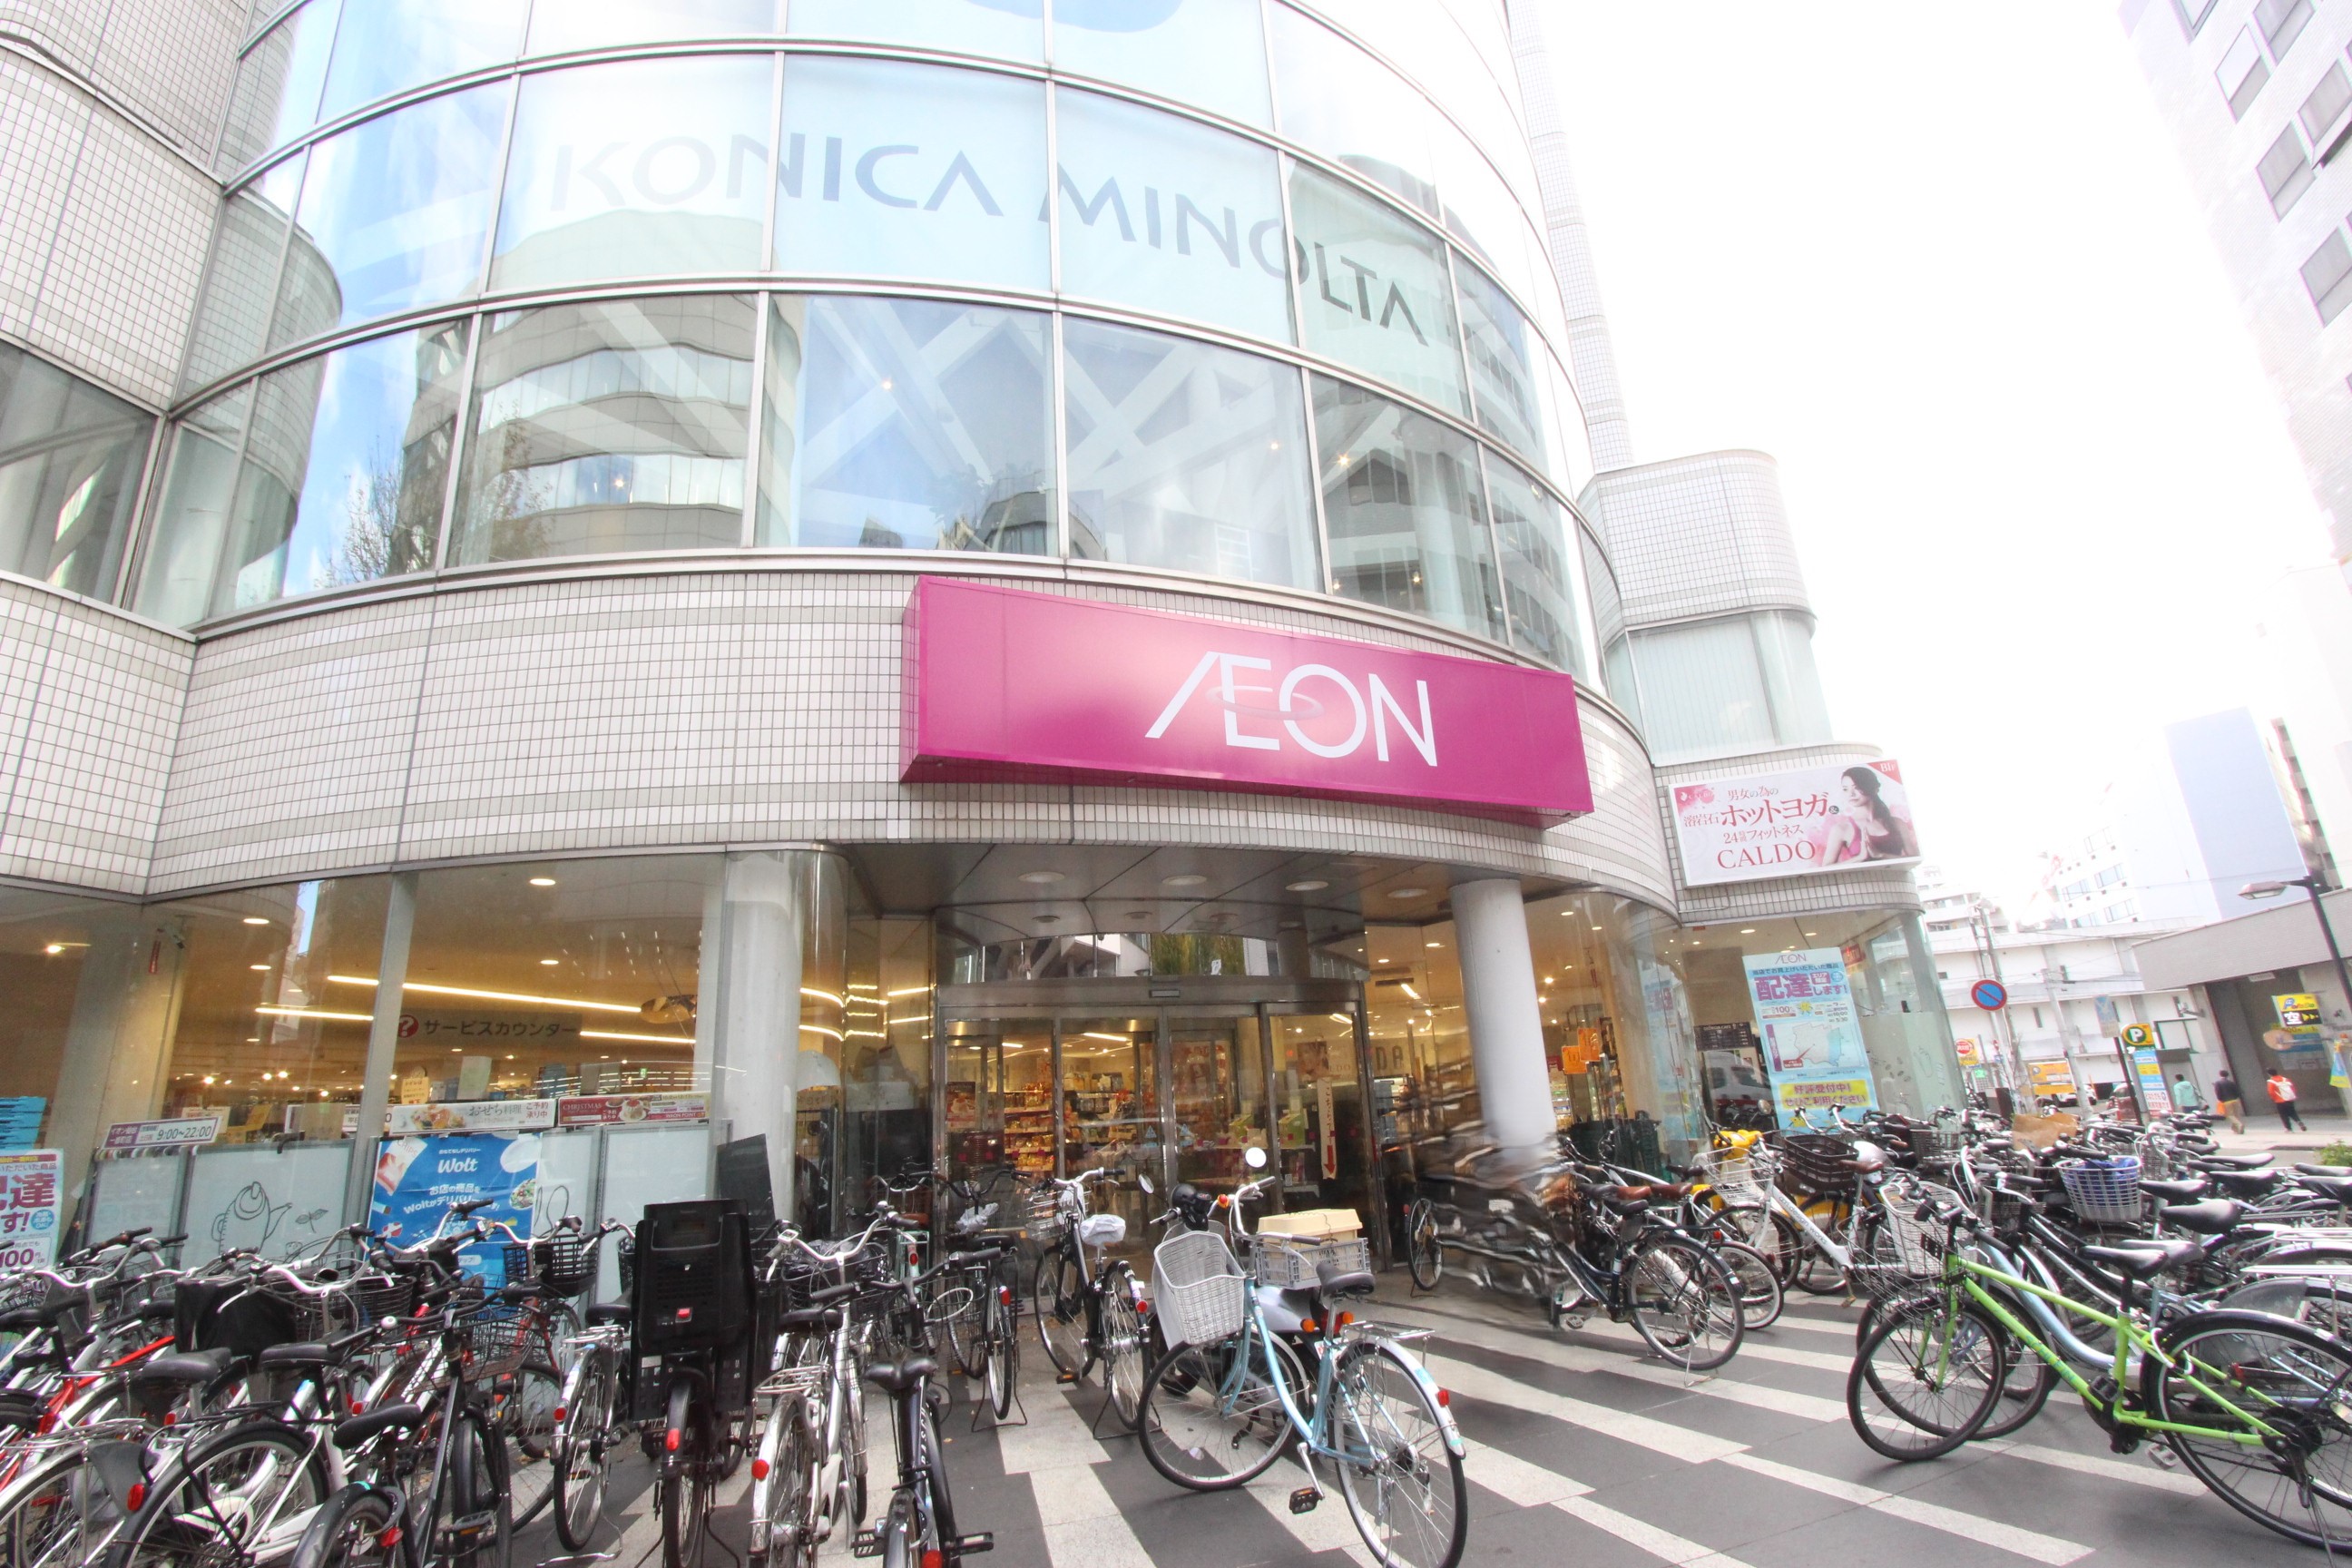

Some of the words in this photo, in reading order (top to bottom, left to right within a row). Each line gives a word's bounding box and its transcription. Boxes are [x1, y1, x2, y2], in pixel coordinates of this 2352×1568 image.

[551, 132, 1004, 217] KONICA
[1038, 162, 1429, 348] MINOLTA
[1727, 786, 1779, 800] 男女の為の
[1717, 840, 1815, 869] CALDO
[1754, 973, 1813, 1001] 配達
[424, 1020, 576, 1036] サービスカウンター
[468, 1103, 522, 1116] おせち料理
[525, 1102, 549, 1110] ご予約
[563, 1102, 603, 1111] CHRISTMAS
[437, 1157, 479, 1173] Wolt
[429, 1182, 481, 1196] お店の商品を
